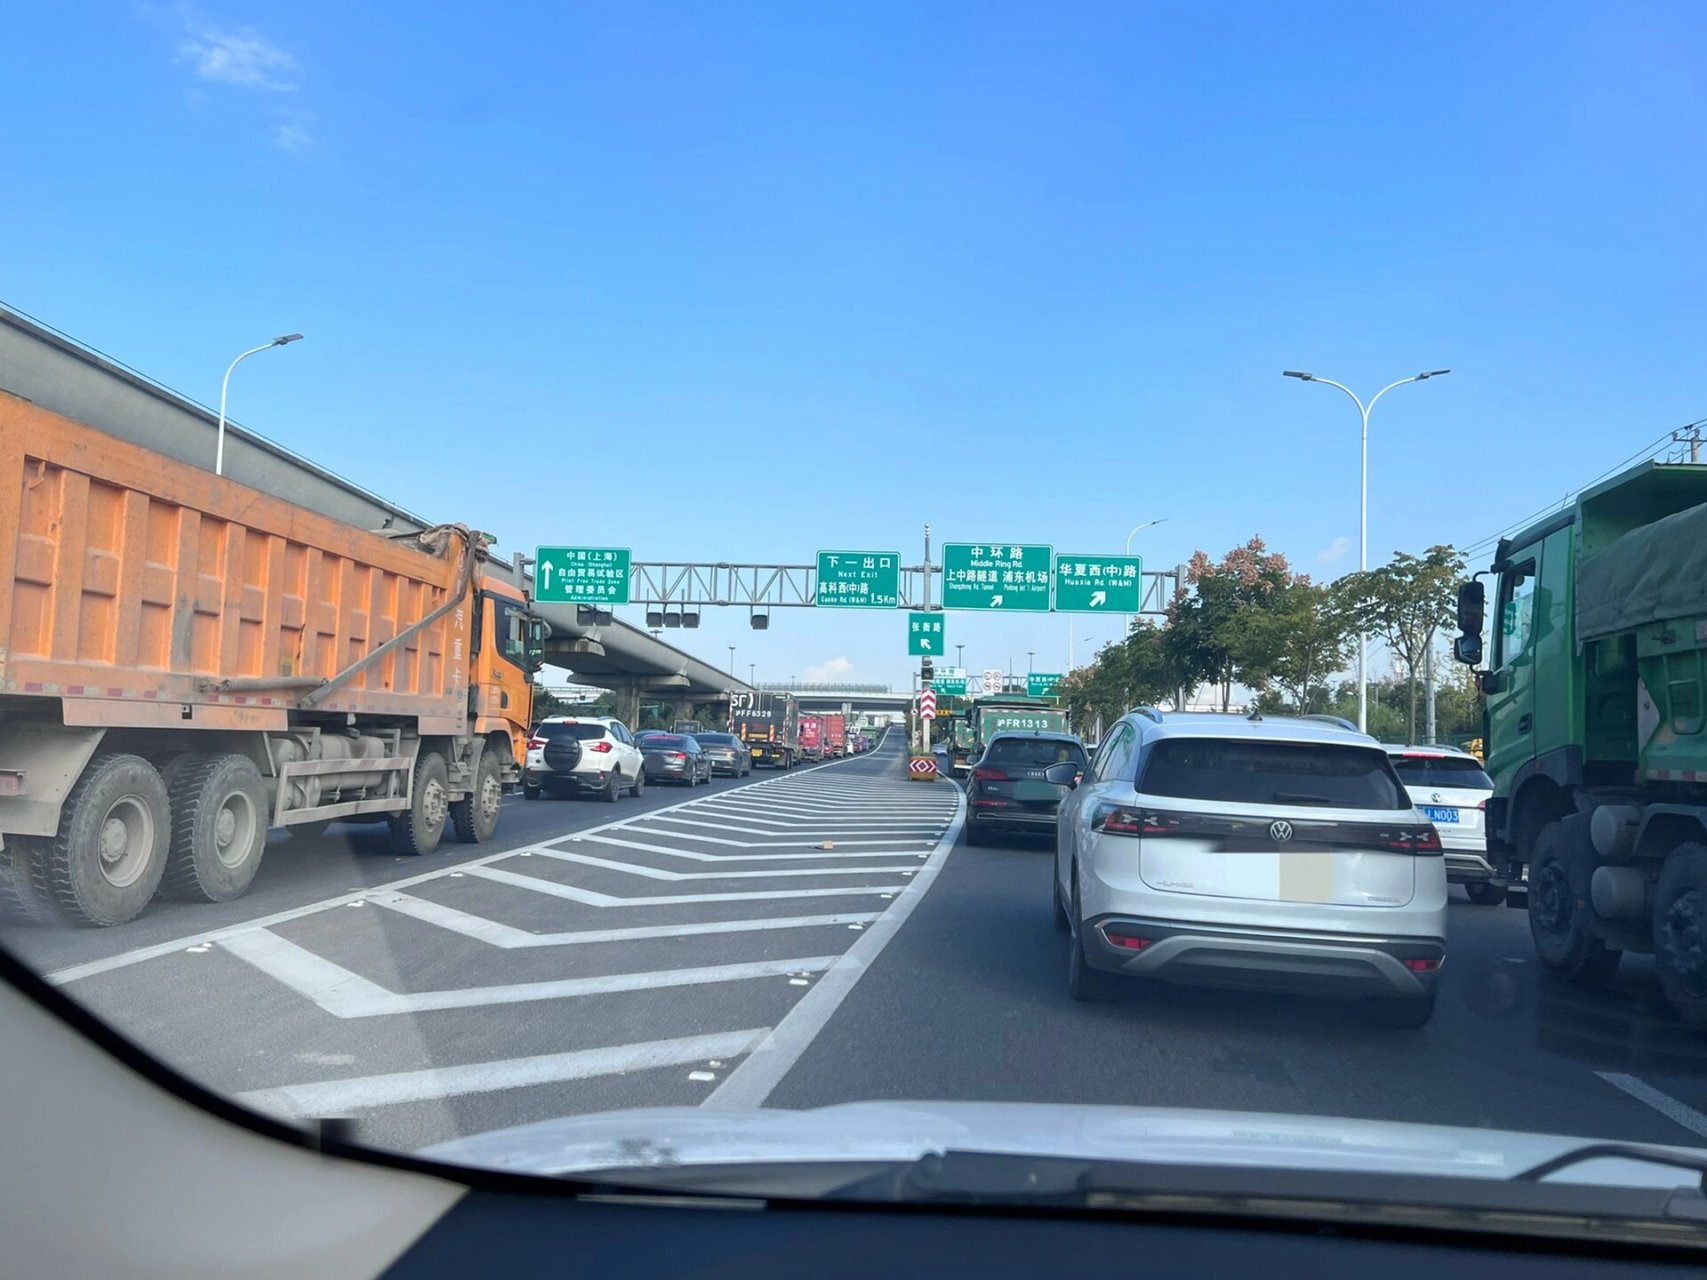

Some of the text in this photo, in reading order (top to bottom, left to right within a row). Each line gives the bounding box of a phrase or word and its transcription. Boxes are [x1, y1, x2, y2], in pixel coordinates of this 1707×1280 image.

[971, 546, 1023, 559] 中环路
[826, 555, 891, 569] 下一出口
[995, 560, 1011, 569] Ring
[558, 568, 624, 578] 自由贸易试验区
[946, 569, 1048, 583] 上中路隧道 浦东机场
[1059, 563, 1137, 578] 华夏西(中)路
[819, 581, 869, 594] 高科西(中)路
[1064, 578, 1091, 586] Huaxia
[1109, 579, 1132, 587] (W&M)
[564, 584, 617, 595] 管理委员会
[870, 593, 896, 604] 1.5Km
[1422, 808, 1459, 822] LN003
